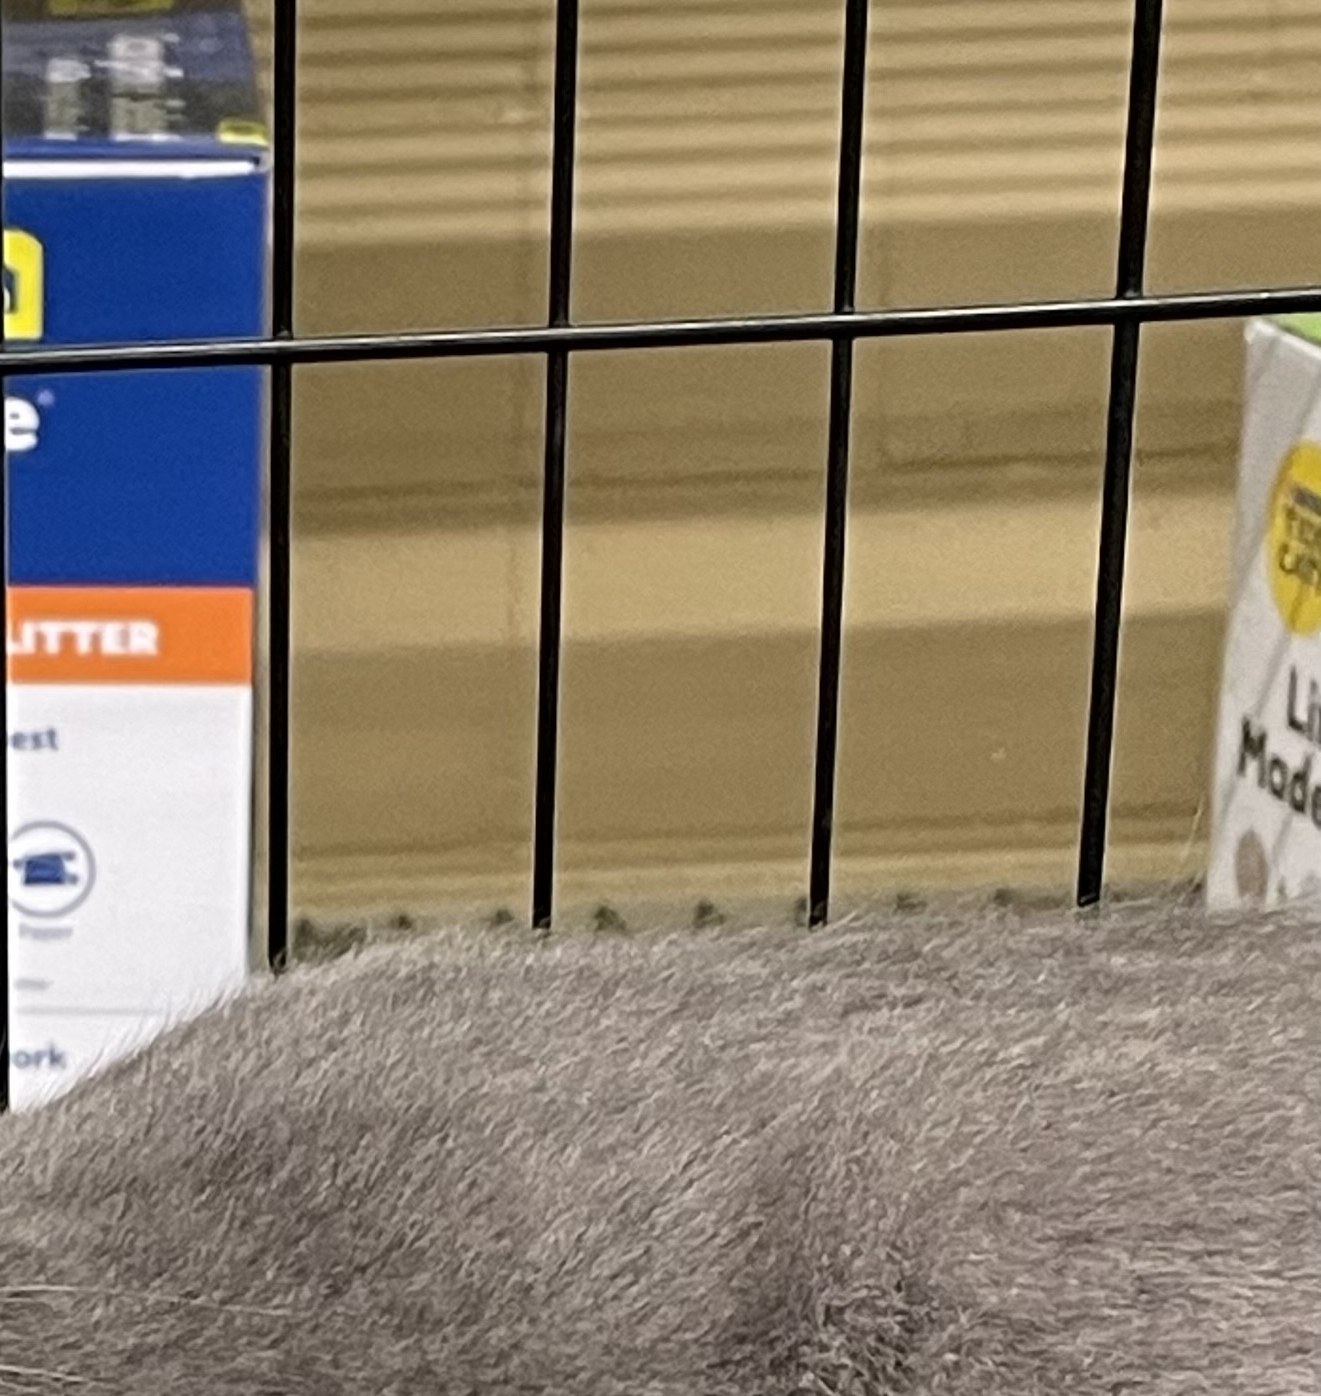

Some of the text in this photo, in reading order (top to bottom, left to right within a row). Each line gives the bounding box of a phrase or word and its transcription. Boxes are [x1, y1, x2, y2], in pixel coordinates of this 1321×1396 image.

[1287, 664, 1321, 746] Li
[9, 727, 59, 751] est
[10, 1043, 66, 1070] ork
